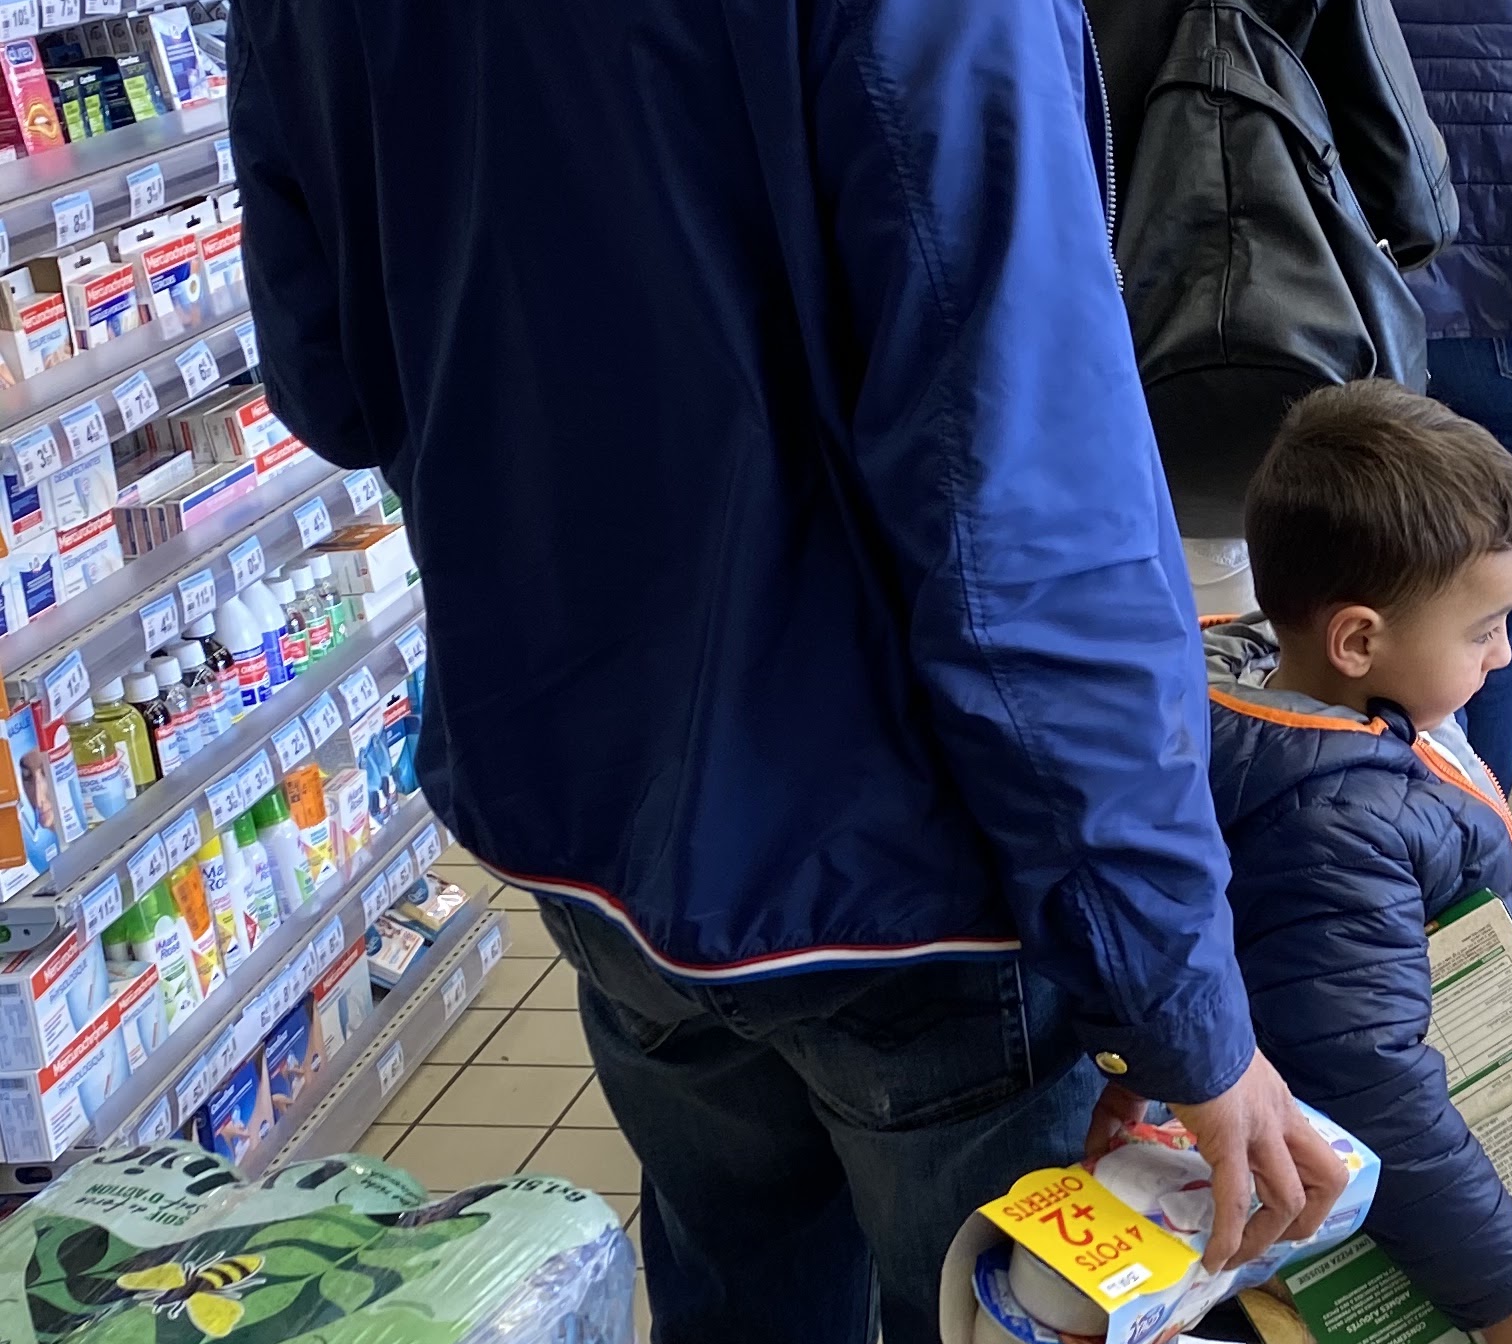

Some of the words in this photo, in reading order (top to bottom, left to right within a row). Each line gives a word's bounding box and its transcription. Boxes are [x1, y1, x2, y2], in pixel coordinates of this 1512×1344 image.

[53, 1020, 110, 1077] Mercurochrome
[1002, 1173, 1083, 1224] OFFERTS
[1037, 1202, 1094, 1248] +2
[1124, 1223, 1144, 1246] 4
[1073, 1233, 1131, 1274] POTS
[1328, 1246, 1355, 1266] PIZZA
[1295, 1259, 1332, 1287] RÉUSSIE
[1378, 1289, 1412, 1314] ARÔMES
[1344, 1307, 1382, 1335] AJOUTÉS
